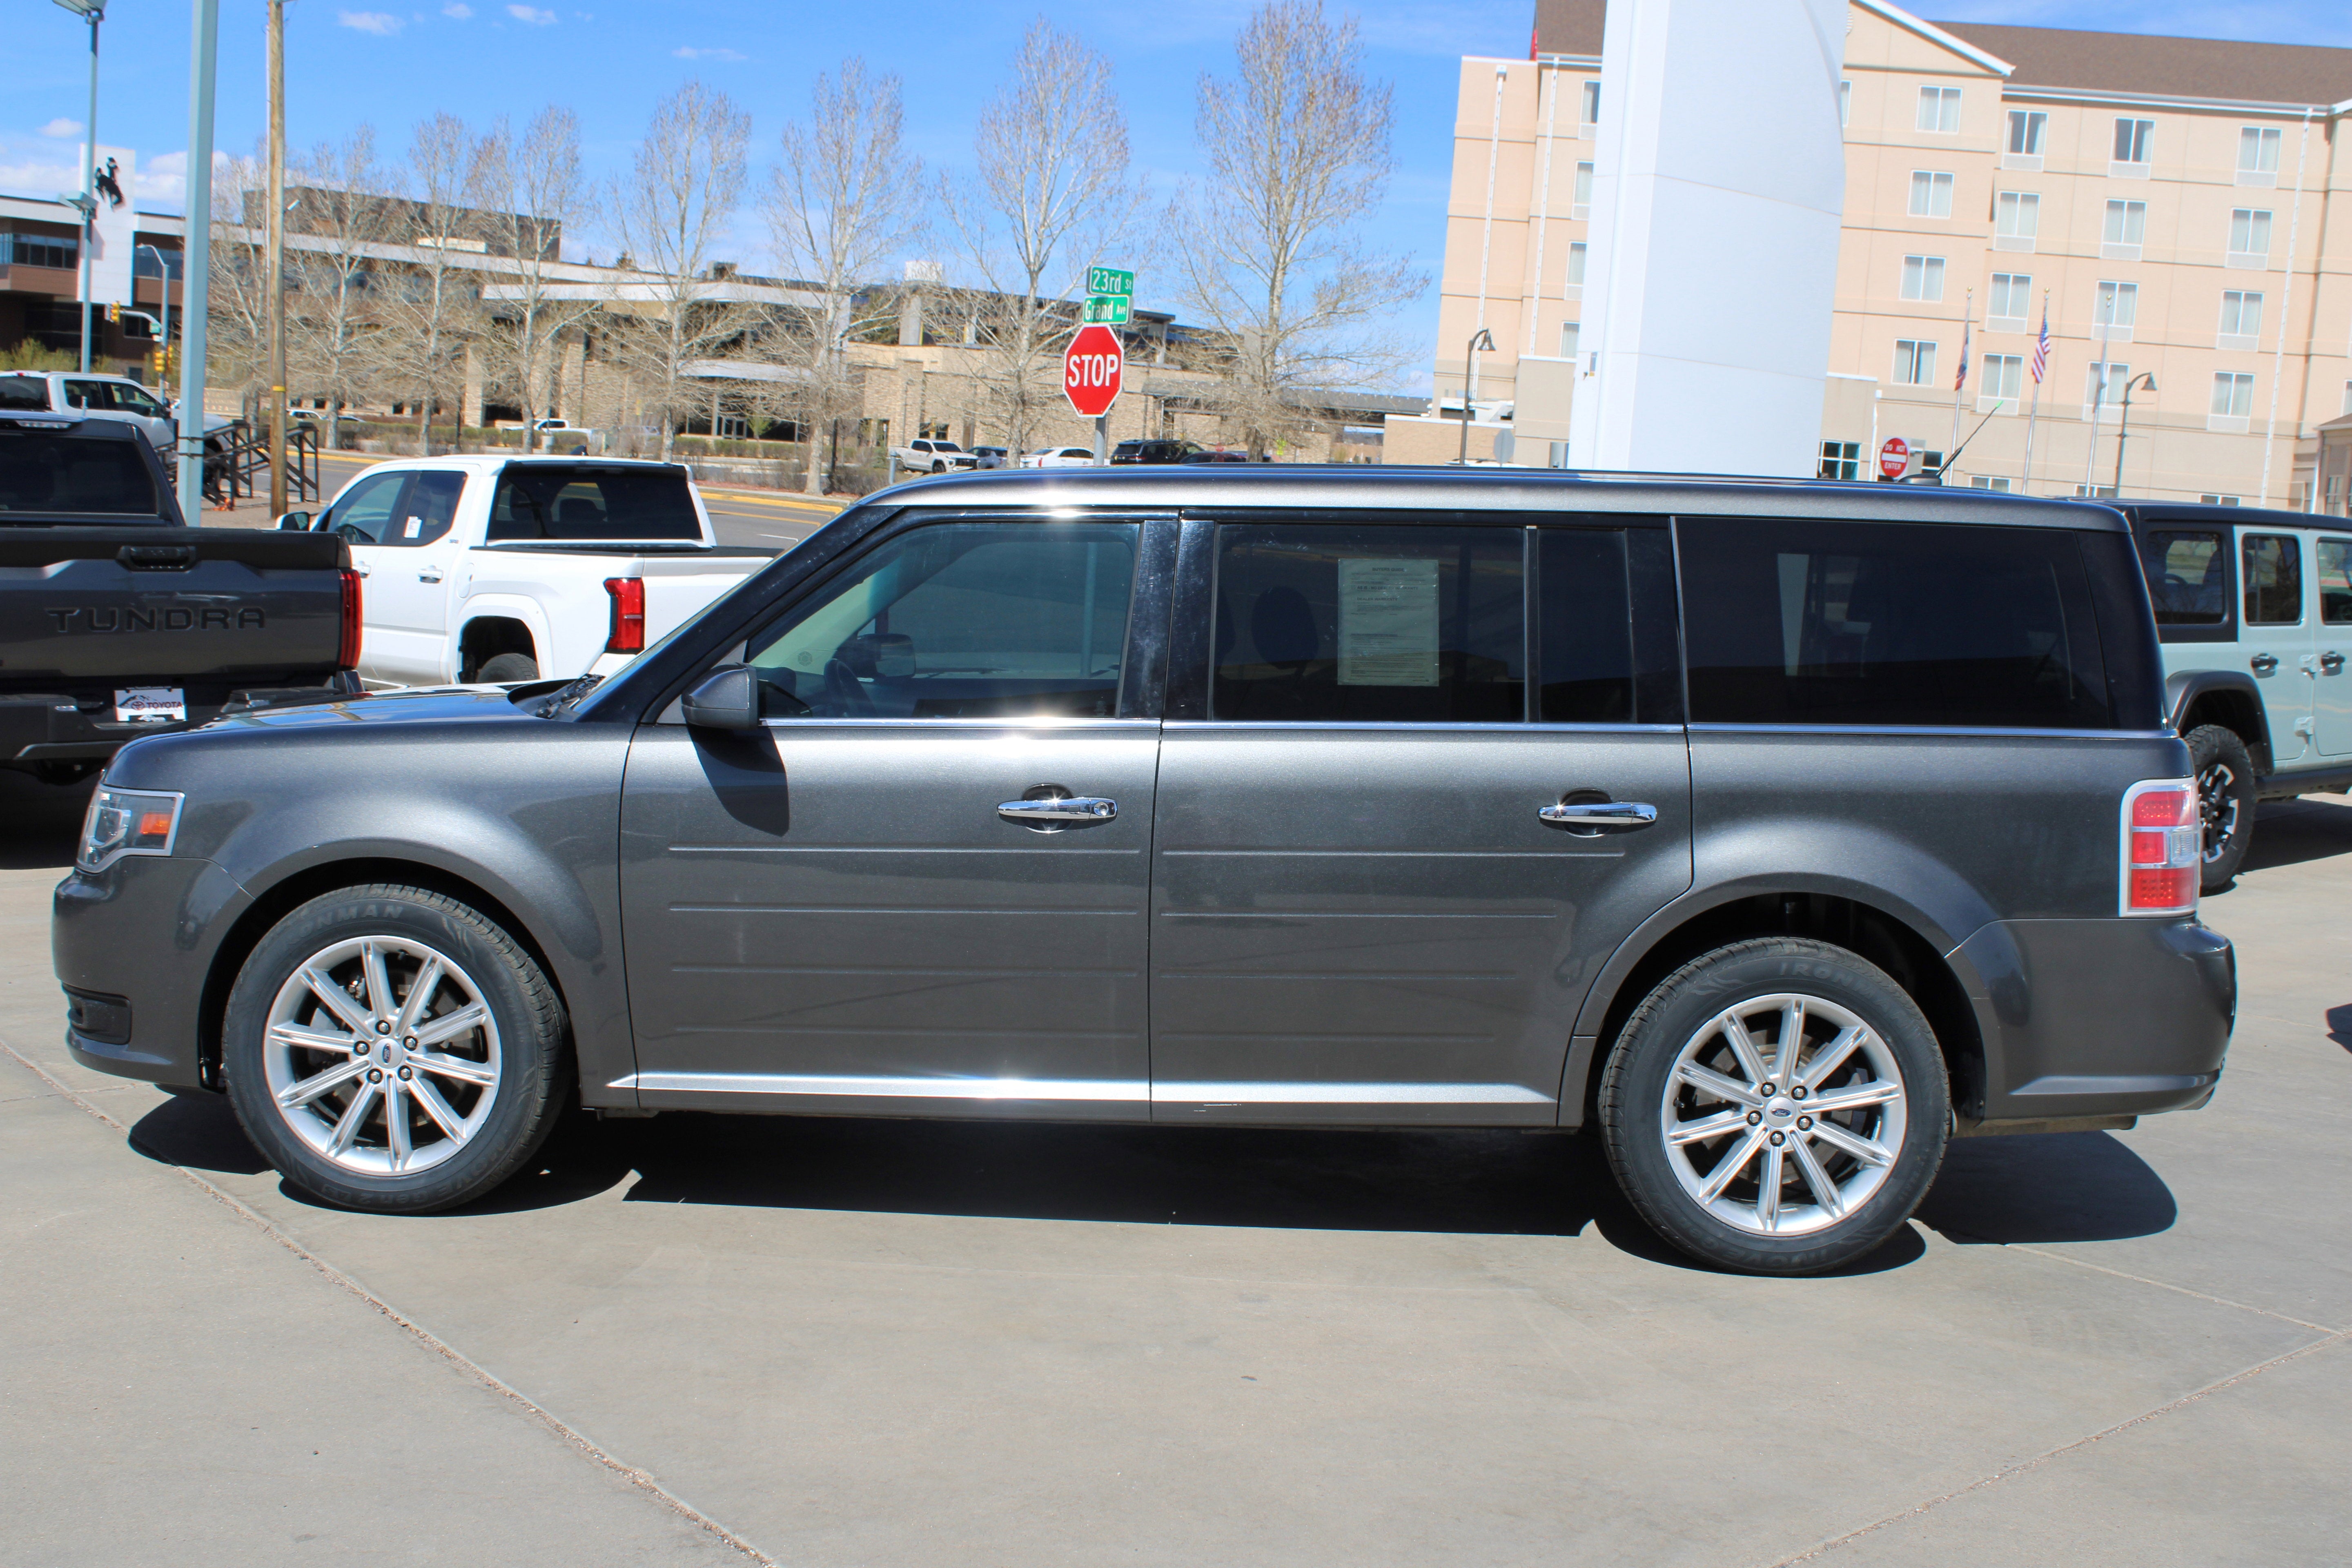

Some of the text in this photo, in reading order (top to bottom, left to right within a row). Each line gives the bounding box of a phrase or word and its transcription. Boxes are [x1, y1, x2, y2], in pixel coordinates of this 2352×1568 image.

[1091, 270, 1132, 294] 23rd St
[1085, 300, 1127, 321] Grand Ave
[1068, 354, 1119, 387] STOP
[1884, 462, 1902, 470] ENTER
[45, 607, 266, 633] TUNDRA
